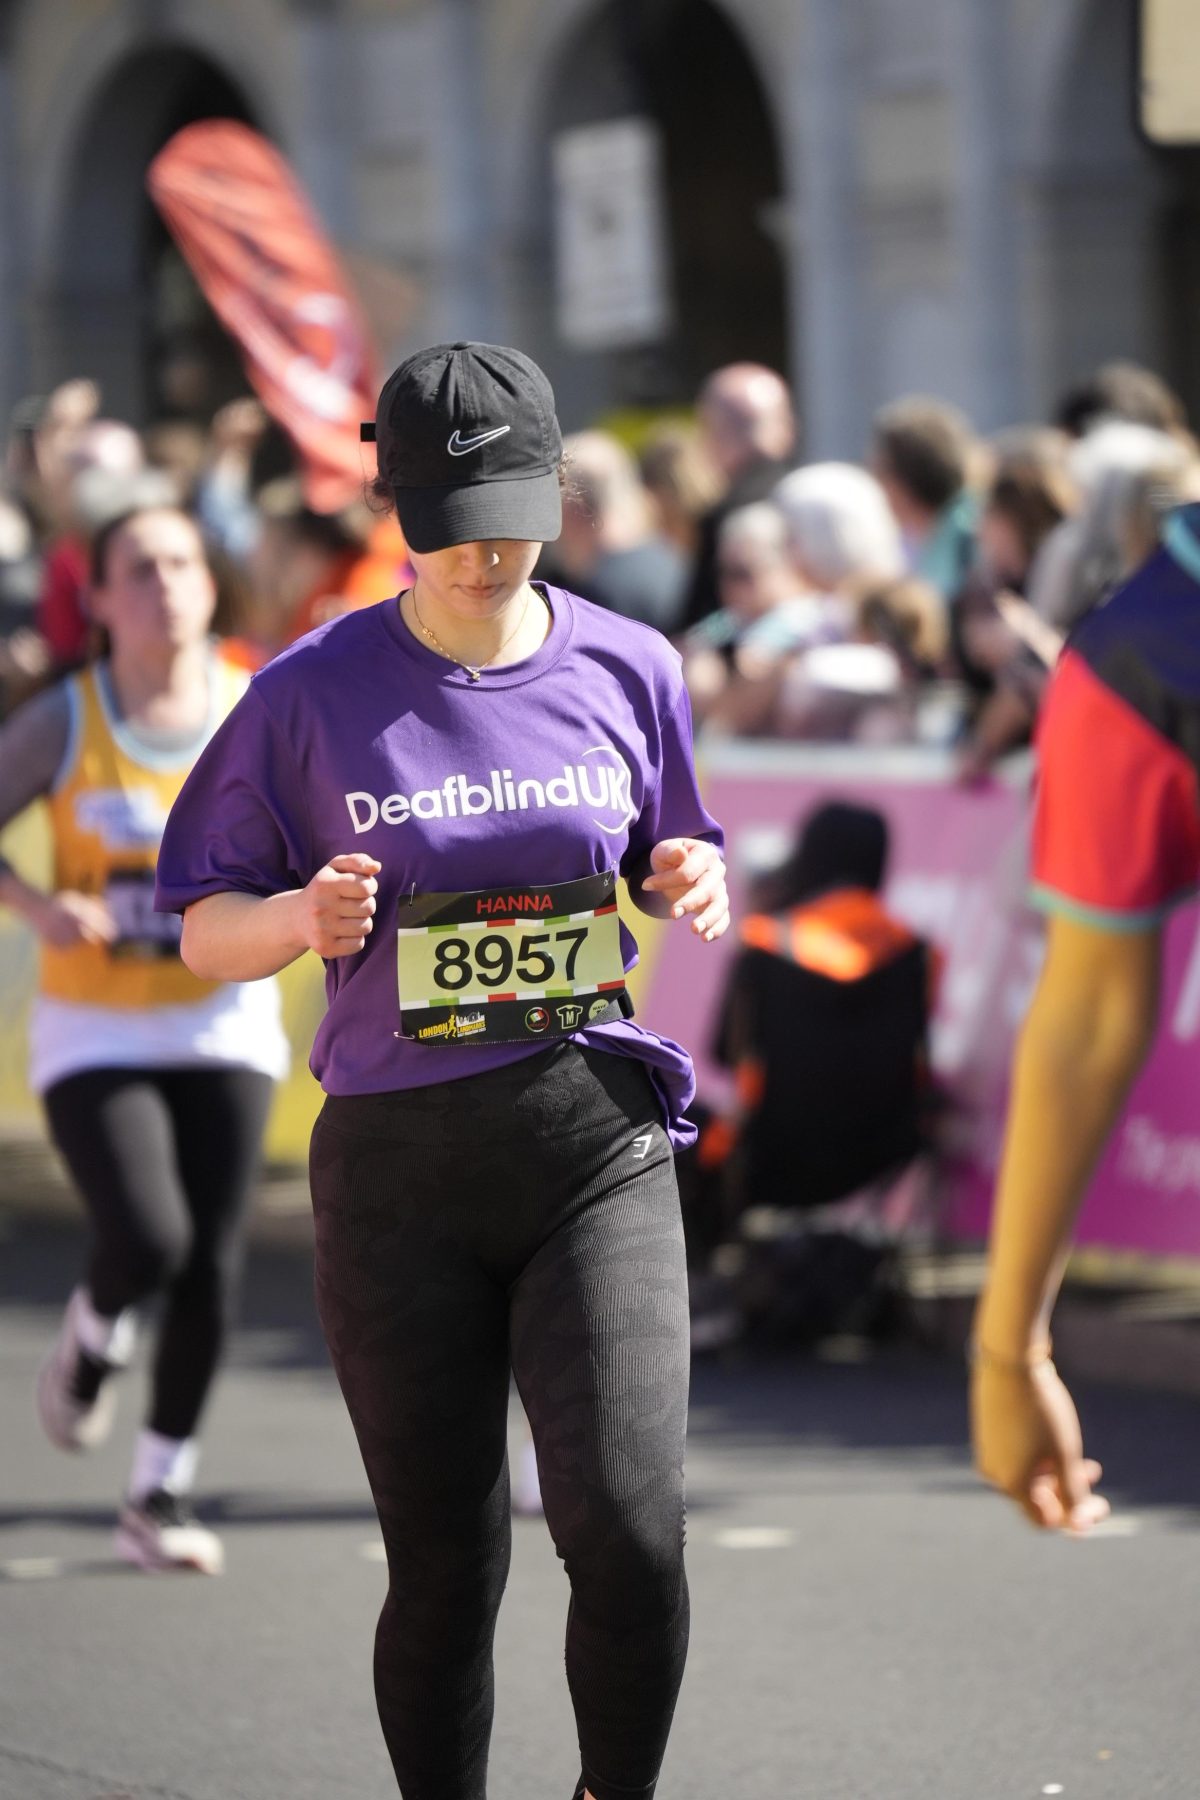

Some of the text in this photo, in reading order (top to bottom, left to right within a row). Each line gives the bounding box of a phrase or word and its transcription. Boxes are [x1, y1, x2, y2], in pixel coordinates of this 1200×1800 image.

[476, 894, 553, 915] HANNA
[433, 927, 589, 990] 8957
[418, 1022, 449, 1039] LONDON
